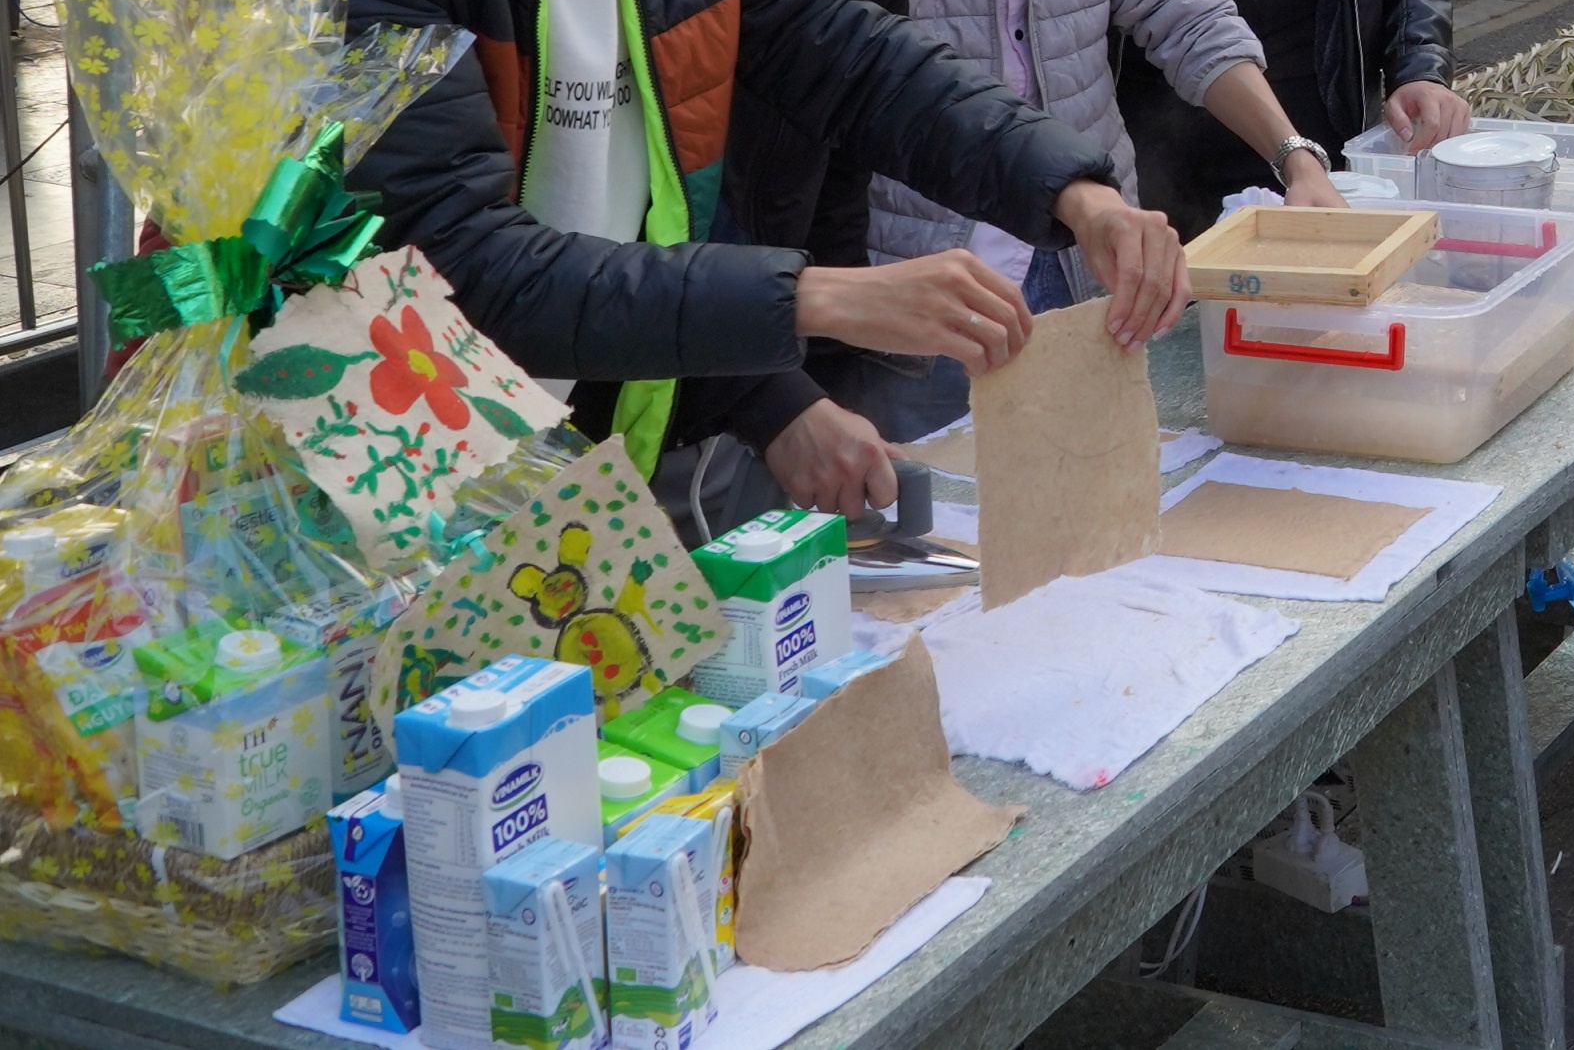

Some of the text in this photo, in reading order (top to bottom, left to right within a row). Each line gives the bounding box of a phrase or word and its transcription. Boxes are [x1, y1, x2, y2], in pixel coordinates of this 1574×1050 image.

[566, 81, 594, 102] YOU
[777, 624, 815, 663] 100%
[779, 648, 819, 682] Fresh Milk
[239, 742, 289, 778] true
[493, 765, 542, 803] VINAMILK
[494, 798, 547, 849] 100%
